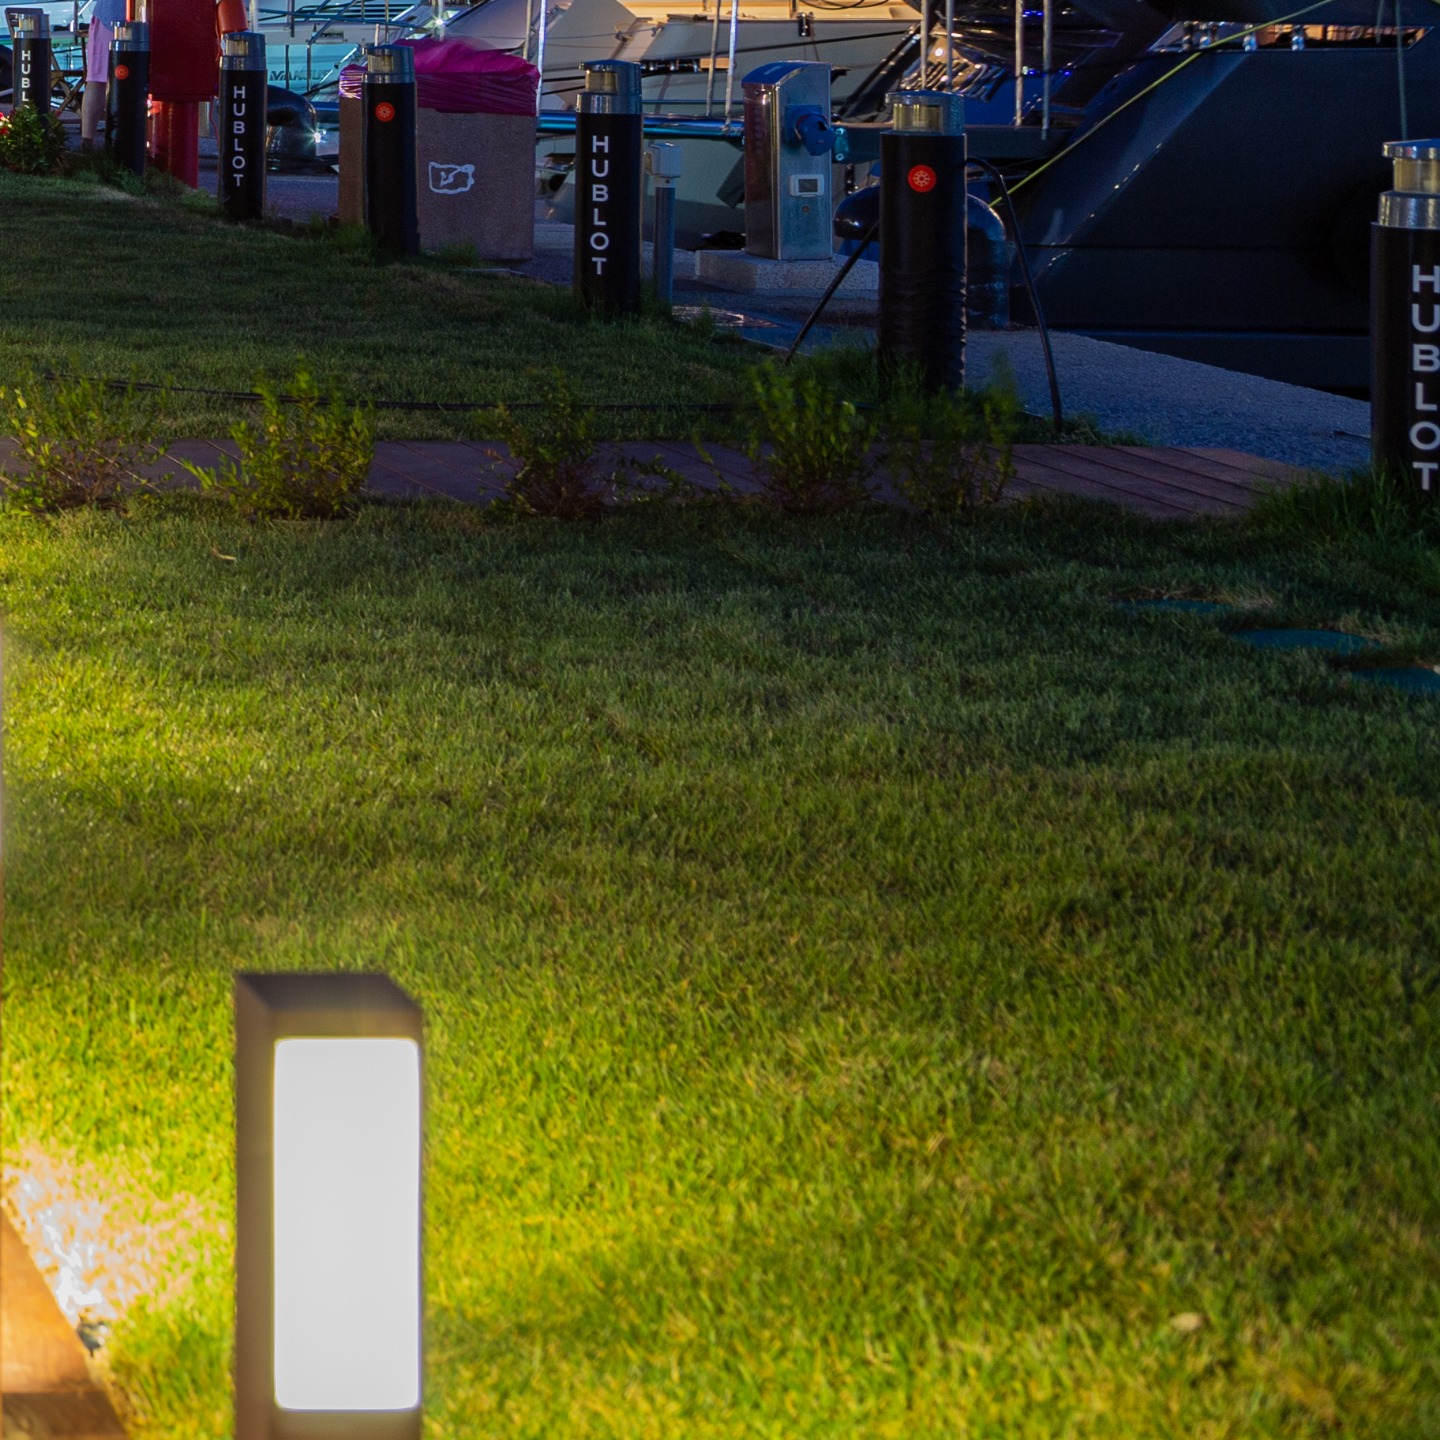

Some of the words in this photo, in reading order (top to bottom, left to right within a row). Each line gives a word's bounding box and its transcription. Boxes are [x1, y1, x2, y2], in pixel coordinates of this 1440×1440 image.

[21, 49, 31, 109] HUBL
[232, 85, 246, 187] HUBLOT
[590, 135, 609, 275] HUBLOT
[1409, 264, 1440, 491] HUBLOT
